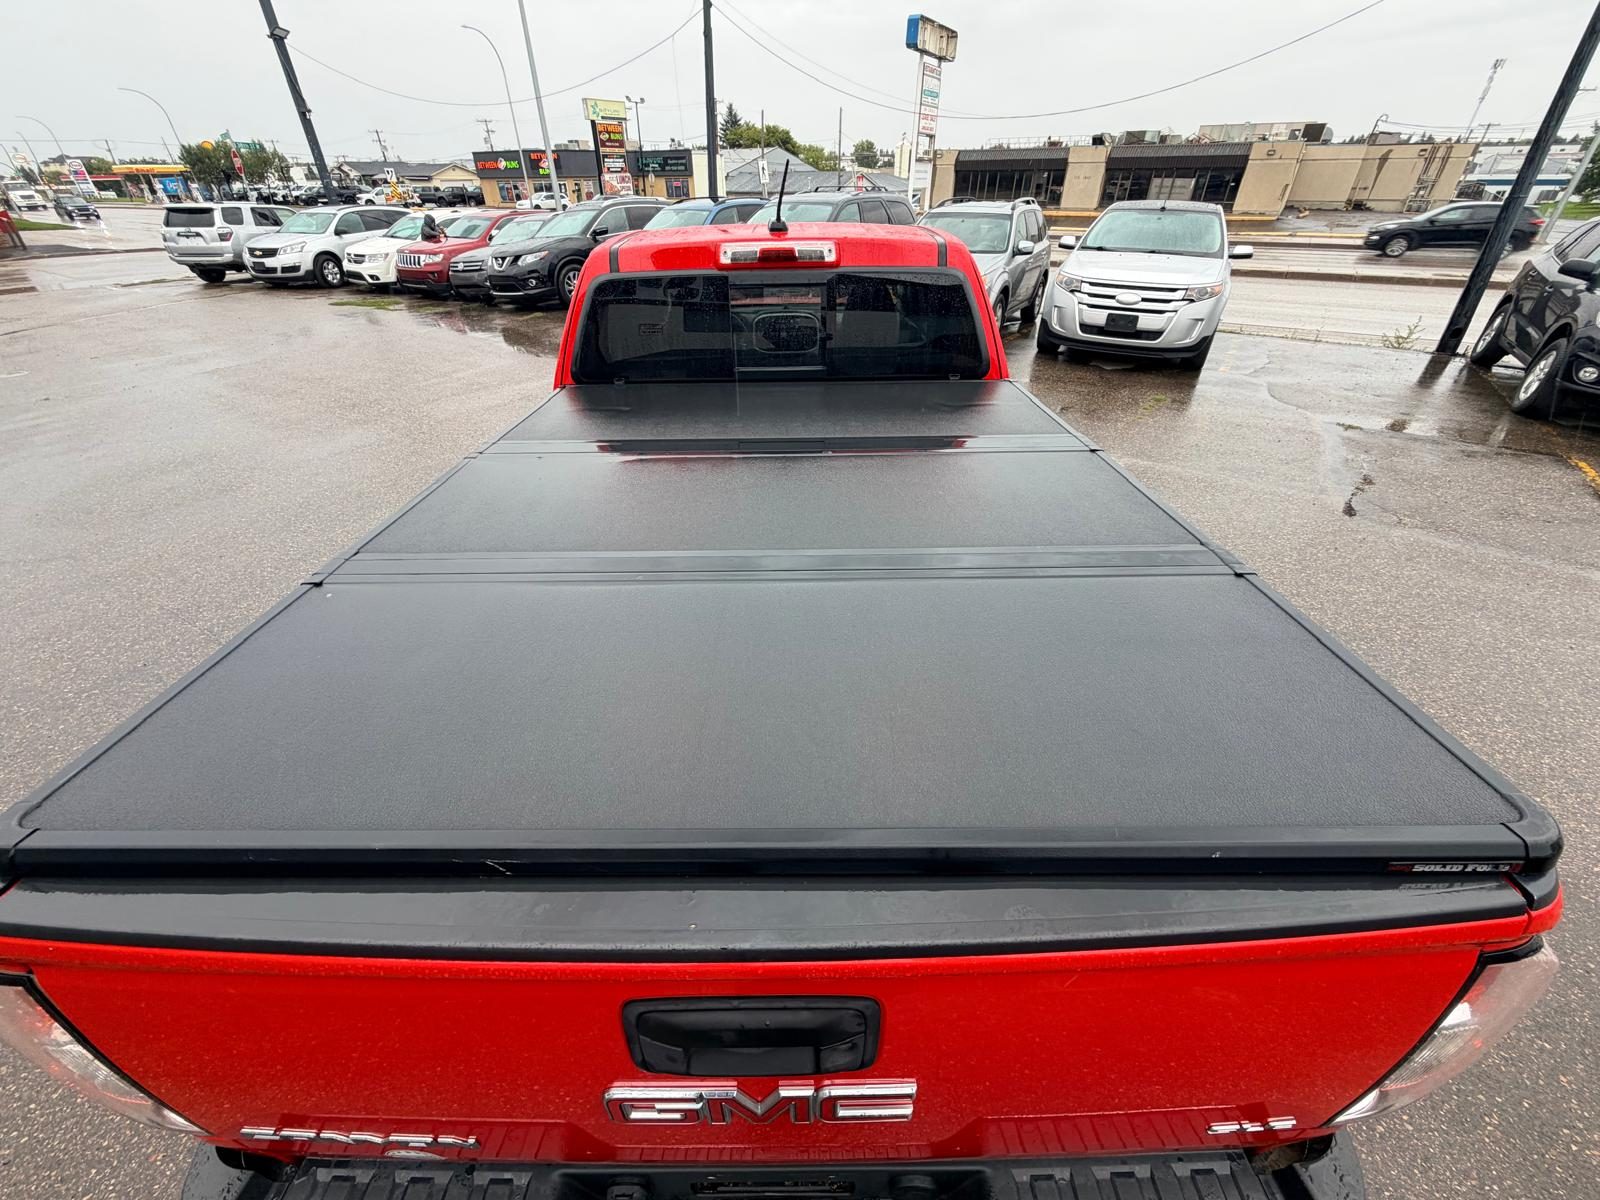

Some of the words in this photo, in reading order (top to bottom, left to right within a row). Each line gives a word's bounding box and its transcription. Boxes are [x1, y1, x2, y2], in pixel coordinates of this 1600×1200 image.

[598, 124, 623, 132] BETWEEN
[477, 161, 498, 169] BETWEEN
[506, 160, 520, 169] BUNS
[1411, 864, 1464, 872] SOLID
[603, 1079, 917, 1125] GMC
